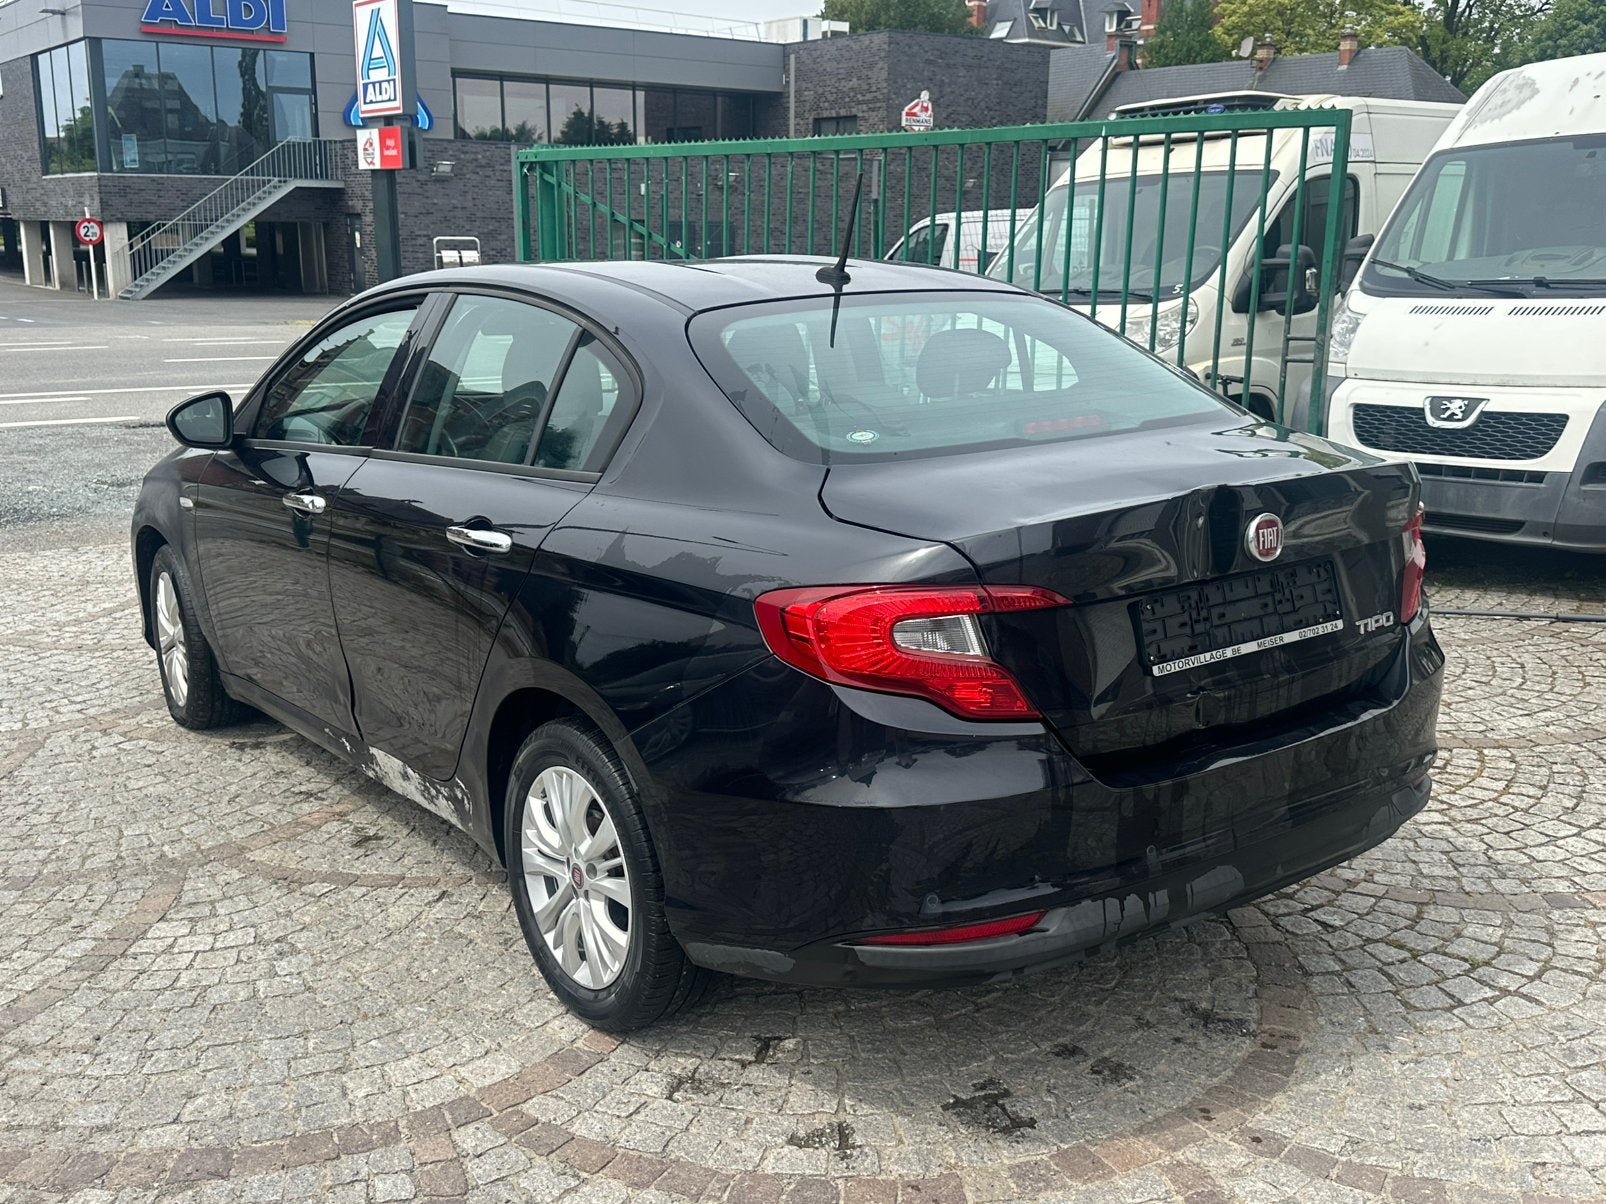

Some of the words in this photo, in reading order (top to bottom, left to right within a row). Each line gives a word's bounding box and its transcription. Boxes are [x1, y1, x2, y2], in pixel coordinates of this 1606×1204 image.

[141, 0, 287, 33] ALDI
[365, 80, 395, 104] ALDI
[83, 225, 90, 237] 2
[1258, 526, 1278, 550] FIAT
[1355, 611, 1394, 635] TIPO
[1157, 649, 1228, 675] MOTORVILLAGE
[1231, 646, 1242, 656] BE
[1256, 635, 1285, 650] MEISER
[1298, 628, 1320, 639] 02/702
[1321, 625, 1329, 634] 31
[1330, 623, 1339, 631] 24
